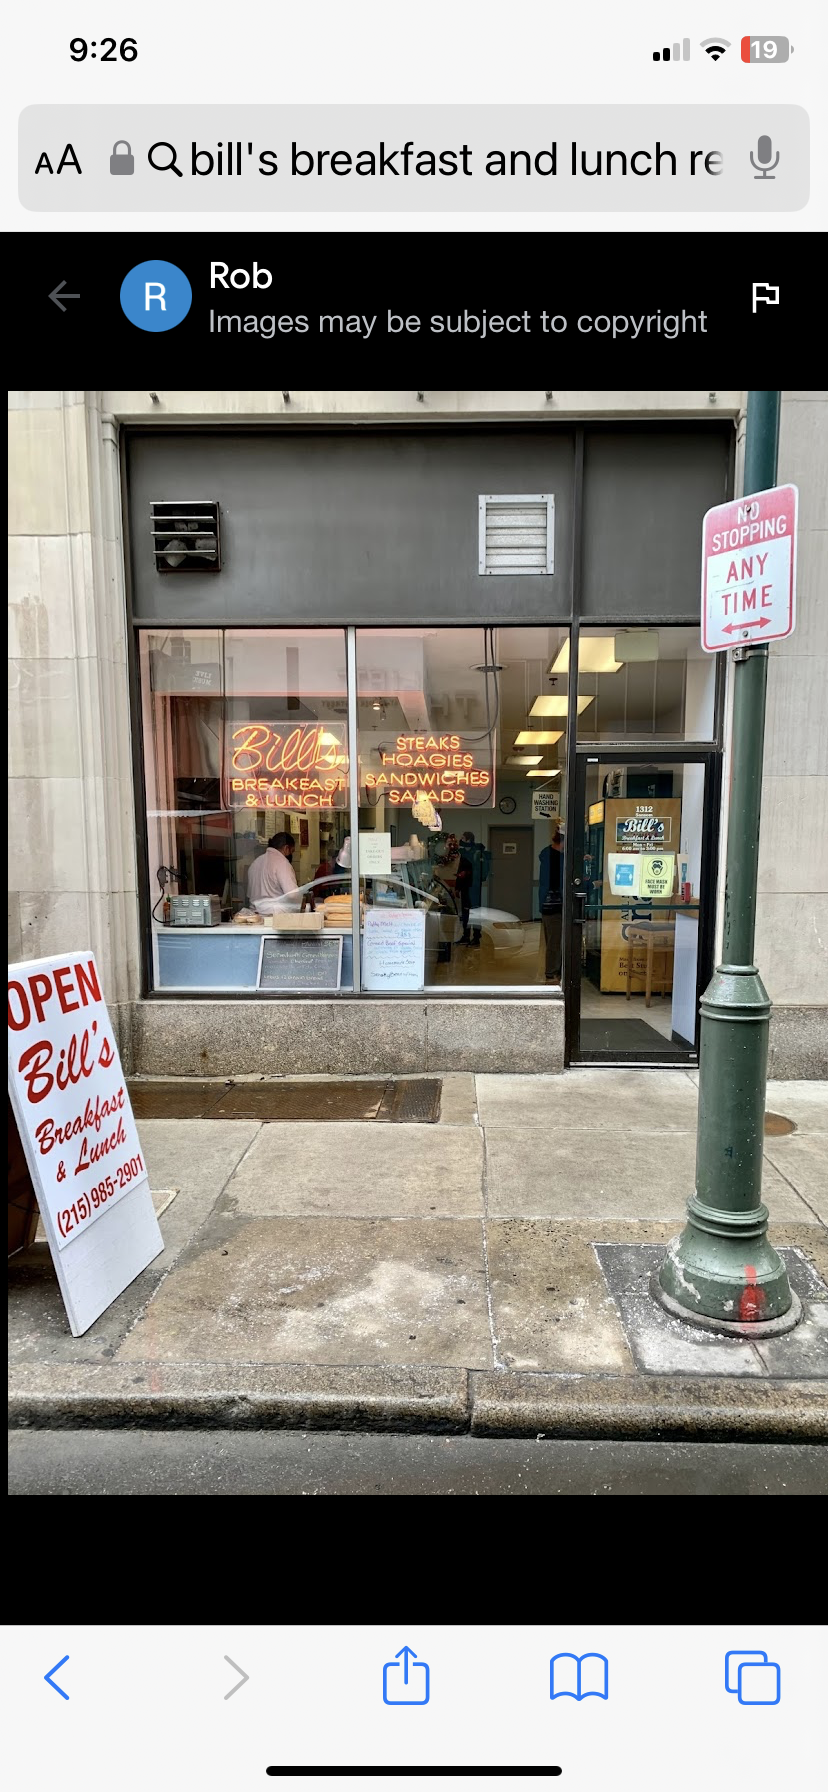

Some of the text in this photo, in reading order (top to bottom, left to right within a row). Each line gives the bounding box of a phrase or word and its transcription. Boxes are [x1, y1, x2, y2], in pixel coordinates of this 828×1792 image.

[737, 501, 760, 525] NO
[712, 514, 787, 552] STOPPING
[726, 552, 769, 584] ANY
[721, 584, 773, 615] TIME
[396, 735, 460, 750] STEAKS
[382, 753, 473, 768] HOAGIES
[364, 771, 490, 786] SANDWICHES
[245, 793, 333, 807] & LUNCH
[622, 818, 664, 833] Bill's
[8, 960, 102, 1031] OPEN
[18, 1020, 115, 1103] Bill's
[35, 1086, 125, 1155] Breakfast
[56, 1116, 126, 1182] & Lunch
